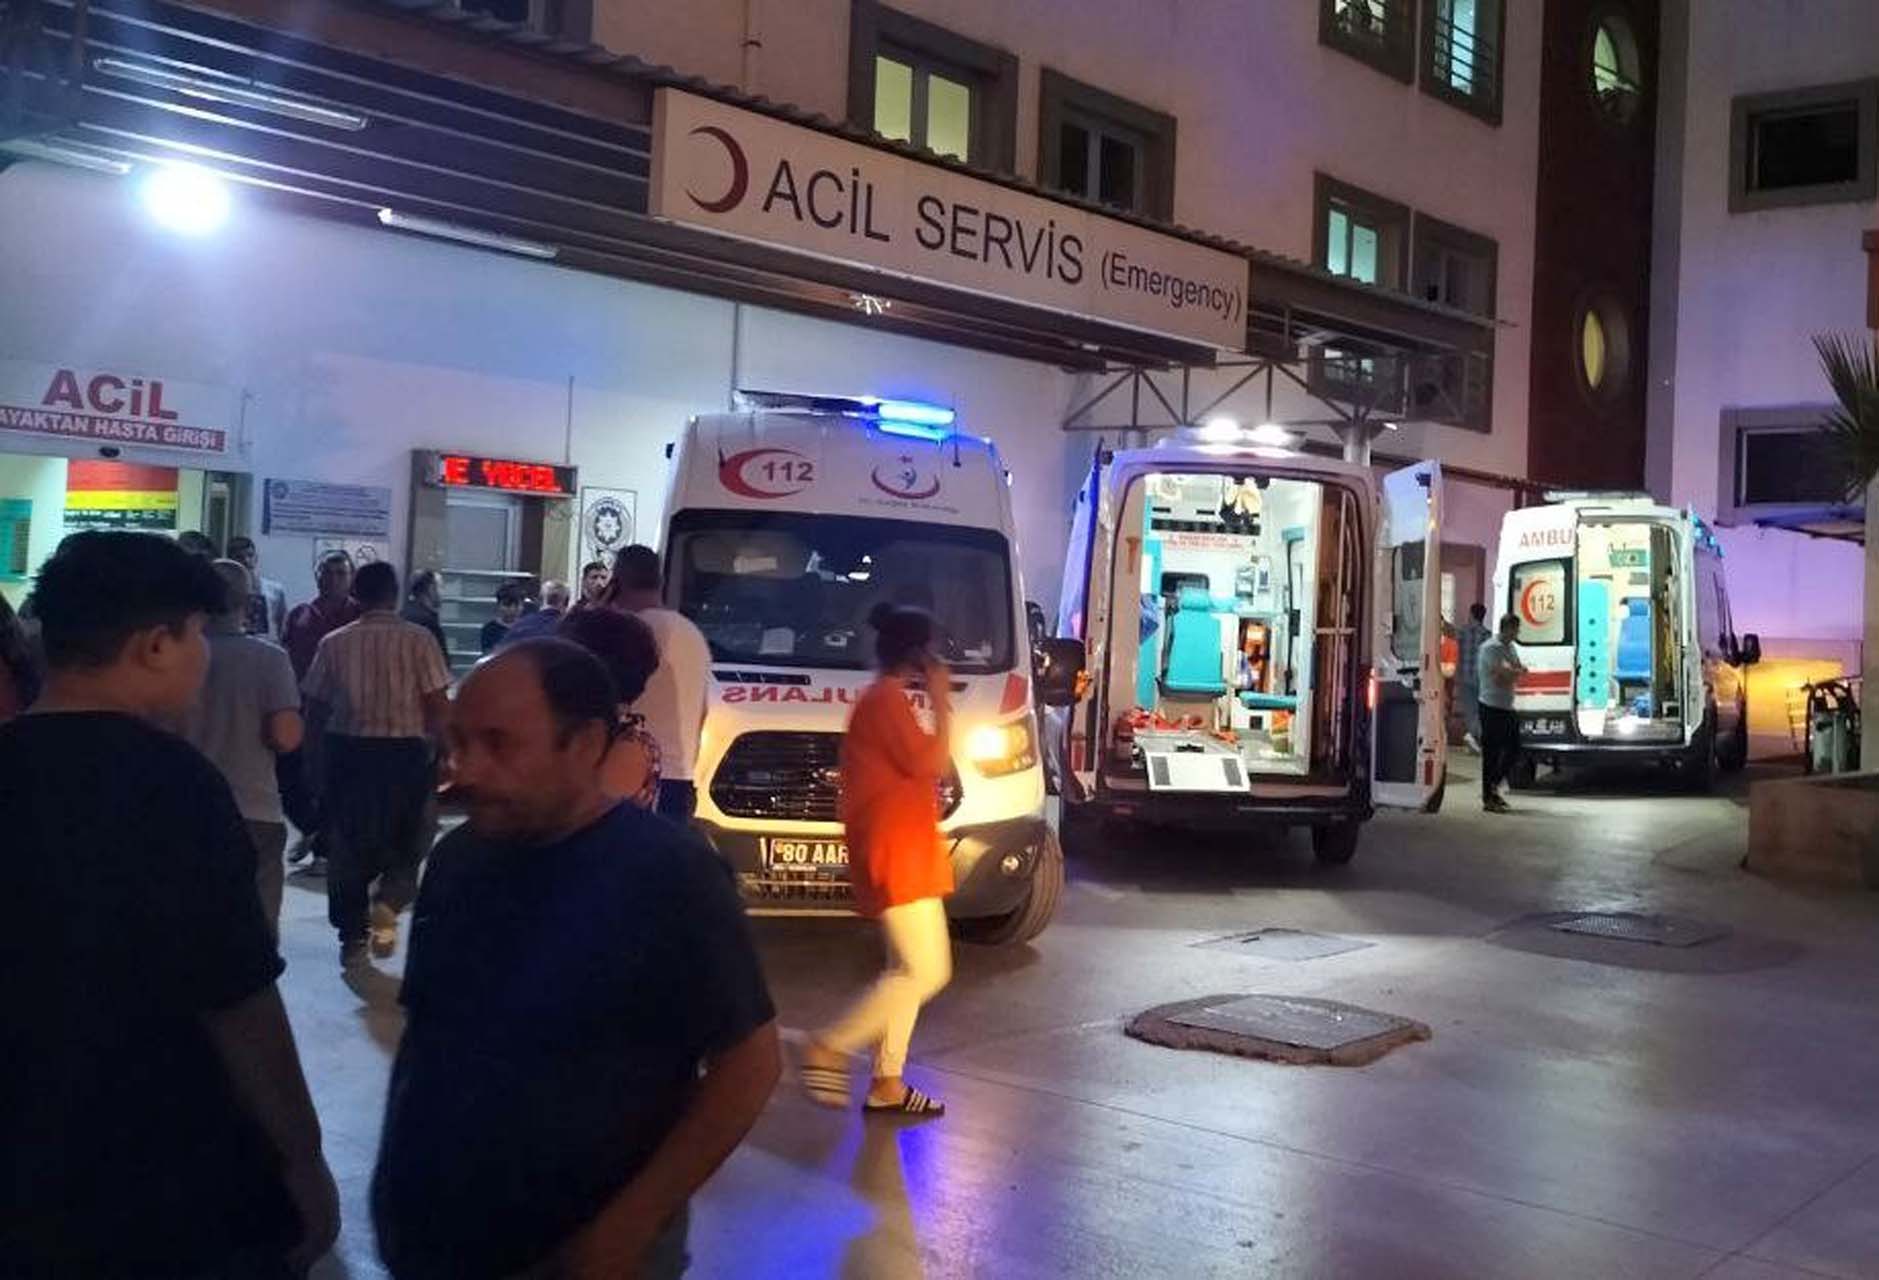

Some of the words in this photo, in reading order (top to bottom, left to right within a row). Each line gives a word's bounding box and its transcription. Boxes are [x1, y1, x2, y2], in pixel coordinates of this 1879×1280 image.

[762, 158, 890, 242] ACİL
[915, 195, 1083, 285] SERVİS
[1101, 250, 1242, 323] (Emergency)
[95, 419, 158, 441] HASTA
[761, 461, 814, 482] 112
[1530, 594, 1555, 612] 112
[782, 843, 808, 862] 80
